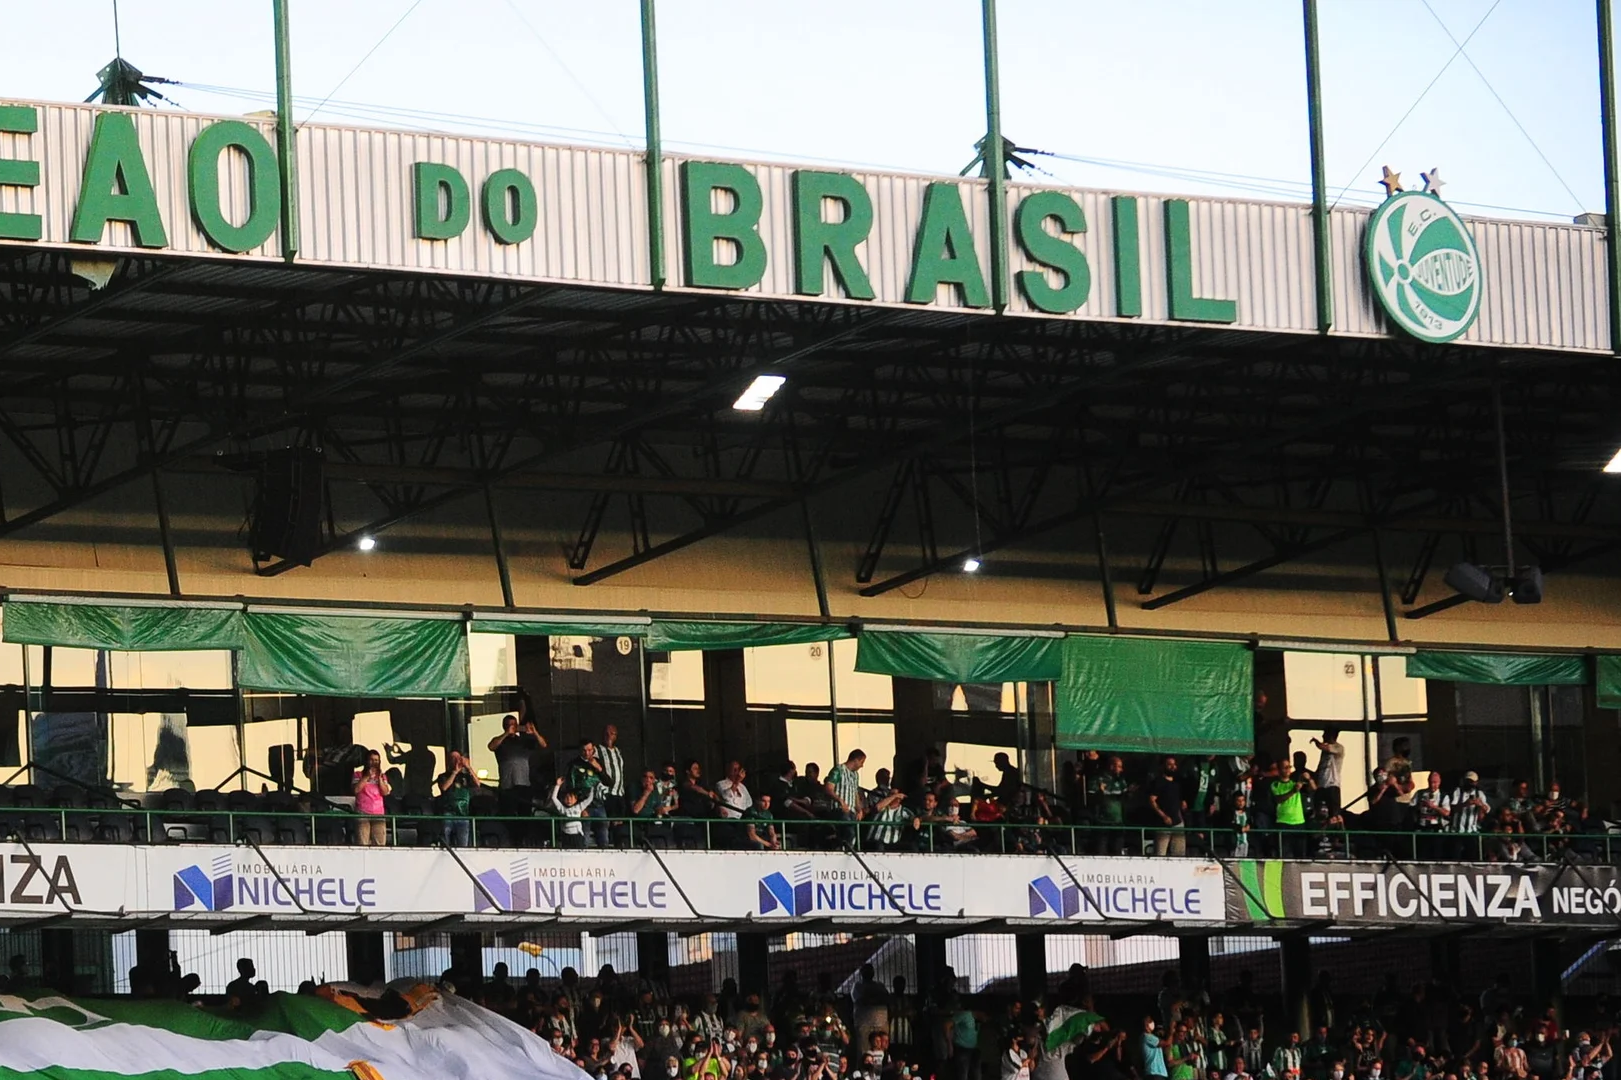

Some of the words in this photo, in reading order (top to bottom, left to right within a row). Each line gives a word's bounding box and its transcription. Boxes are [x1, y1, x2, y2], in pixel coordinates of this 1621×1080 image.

[1407, 208, 1437, 237] E.C.
[413, 161, 538, 246] DO
[680, 159, 1237, 323] BRASIL
[619, 639, 630, 651] 19
[810, 646, 822, 657] 20
[1344, 663, 1355, 674] 23
[238, 877, 376, 907] NICHELE
[530, 880, 667, 909] NICHELE
[816, 881, 941, 911] NICHELE
[1083, 886, 1201, 914] NICHELE
[1300, 872, 1543, 918] EFFICIENZA
